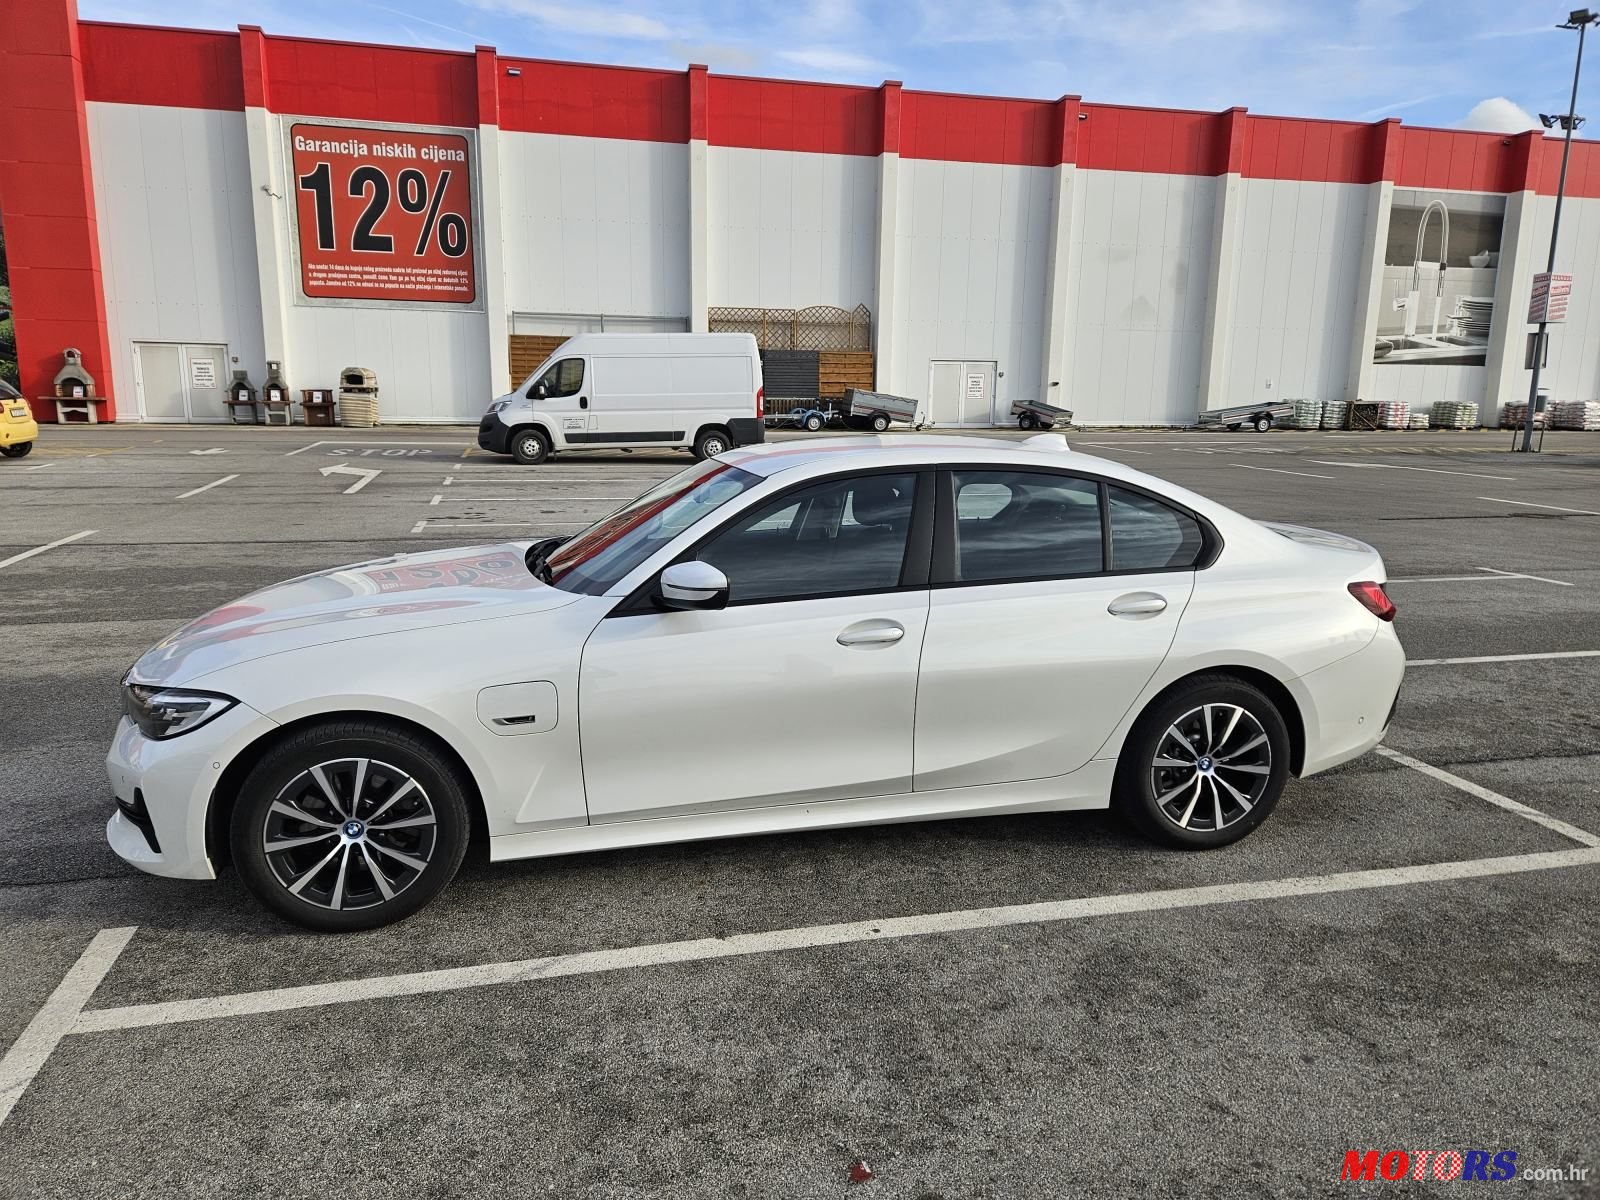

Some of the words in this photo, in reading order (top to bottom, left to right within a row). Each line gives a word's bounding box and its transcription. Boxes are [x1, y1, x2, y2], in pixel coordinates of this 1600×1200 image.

[294, 135, 368, 158] Garancija
[372, 142, 417, 159] niskih
[420, 145, 465, 163] cijena
[299, 161, 469, 258] 12%
[326, 448, 433, 457] STOP
